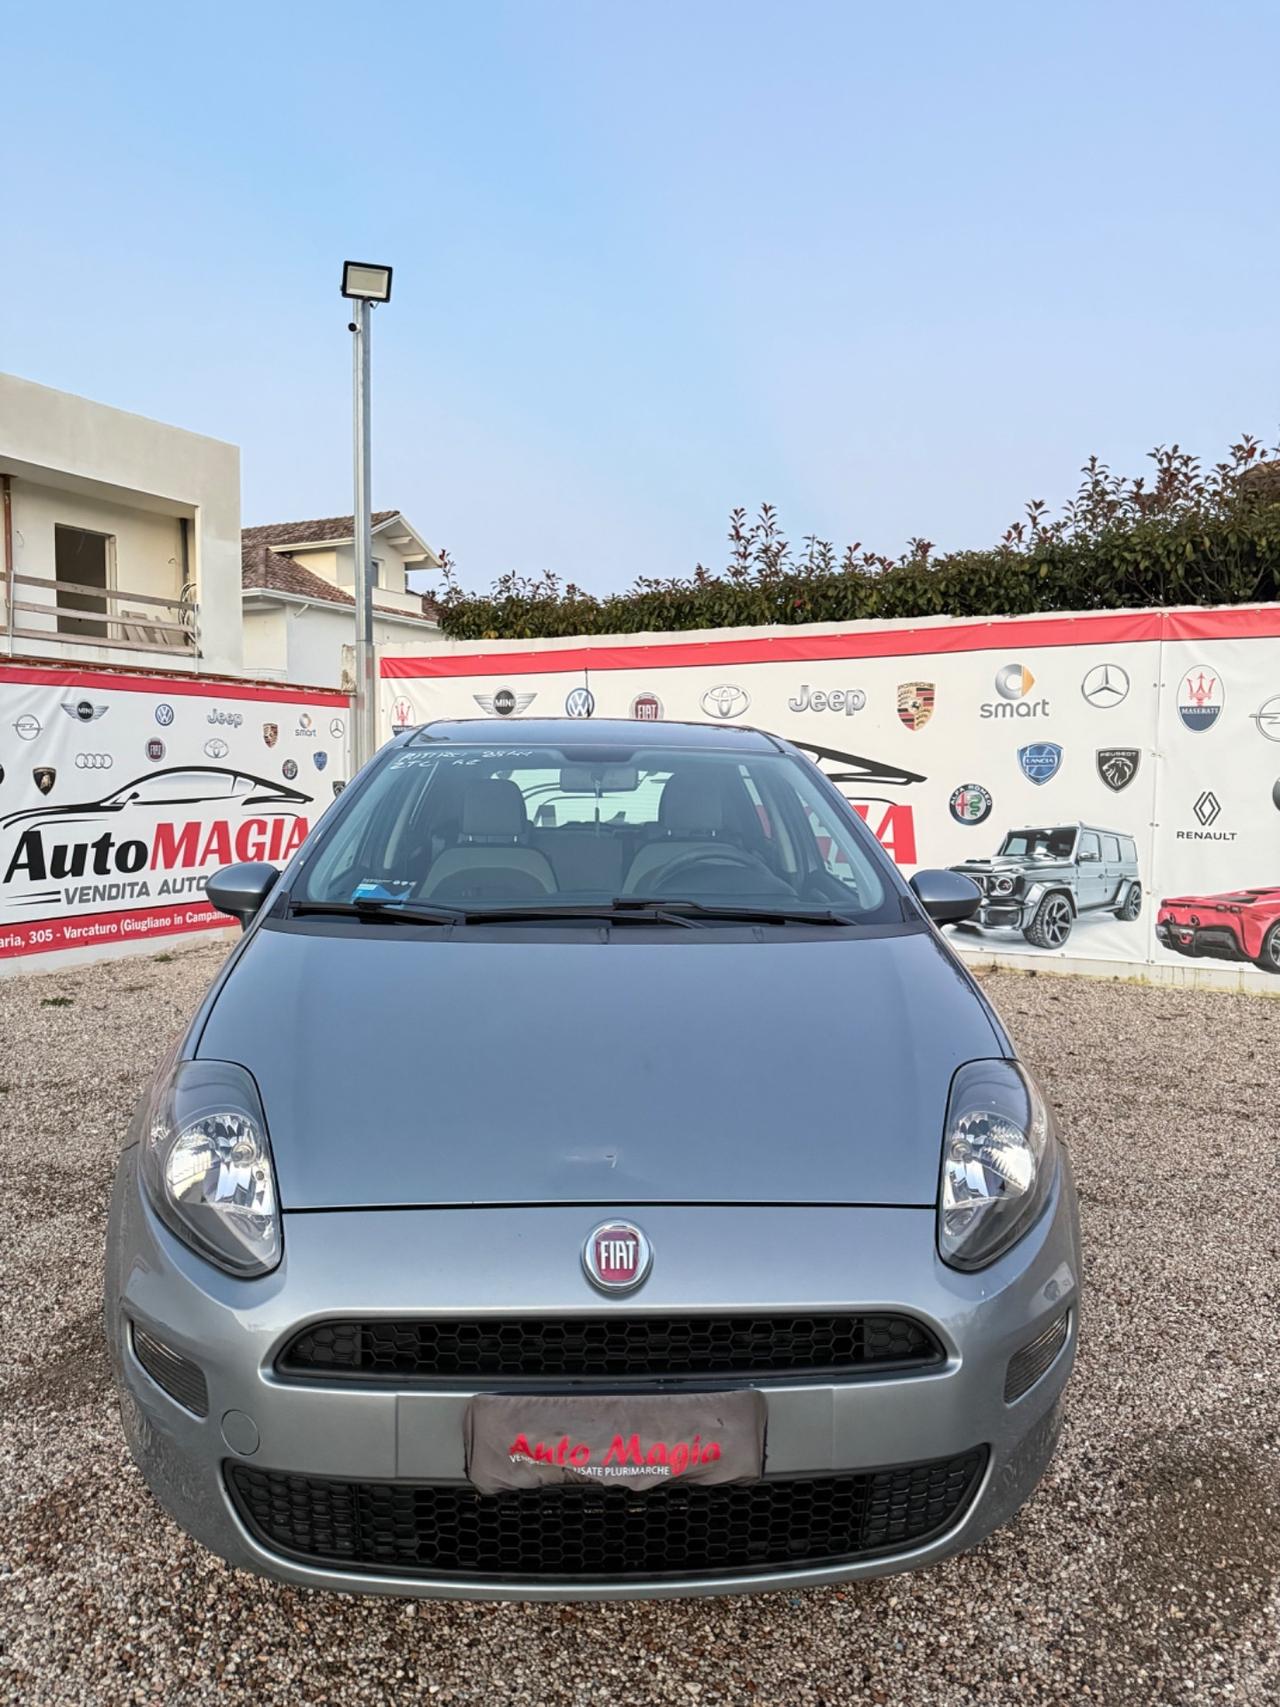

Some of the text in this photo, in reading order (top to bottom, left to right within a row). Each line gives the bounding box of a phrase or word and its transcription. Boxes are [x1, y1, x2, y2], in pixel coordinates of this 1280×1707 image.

[788, 685, 866, 716] Jeep
[980, 699, 1049, 718] smart
[207, 708, 243, 728] Jeep
[637, 704, 657, 720] FIAT
[1181, 707, 1219, 715] MASERATI
[295, 728, 317, 737] smart
[1026, 757, 1054, 765] LANCIA
[1176, 831, 1237, 841] RENAULT
[64, 882, 150, 905] VENDITA
[29, 928, 54, 945] 305
[63, 922, 118, 940] Varcaturo
[120, 914, 171, 936] (Giugliano
[174, 914, 183, 925] in
[600, 1240, 636, 1270] FIAT
[509, 1433, 721, 1476] Auto Magia
[605, 1466, 670, 1477] PLURIMARCHE
